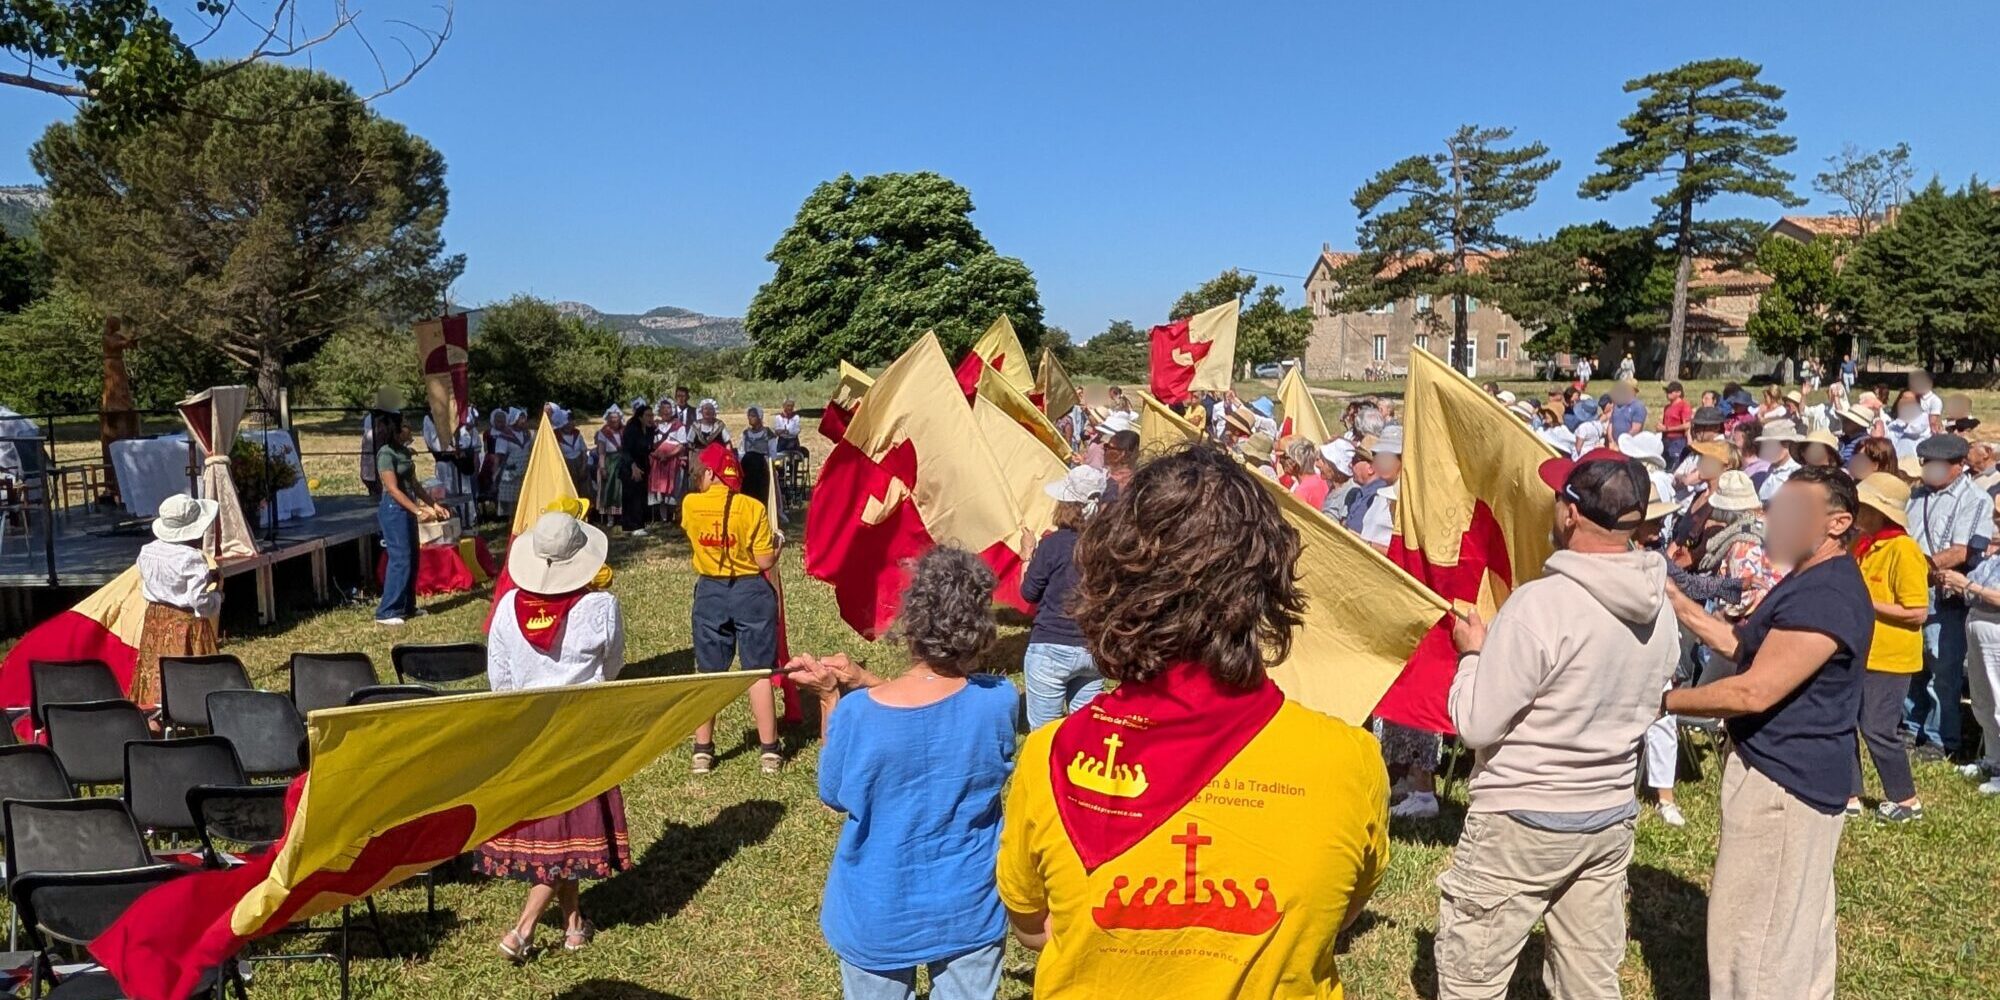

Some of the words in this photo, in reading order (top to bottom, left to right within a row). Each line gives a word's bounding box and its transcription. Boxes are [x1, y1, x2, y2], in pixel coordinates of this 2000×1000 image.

[1223, 778, 1231, 789] à
[1234, 778, 1245, 790] la
[1248, 780, 1306, 796] Tradition
[1205, 792, 1265, 808] Provence
